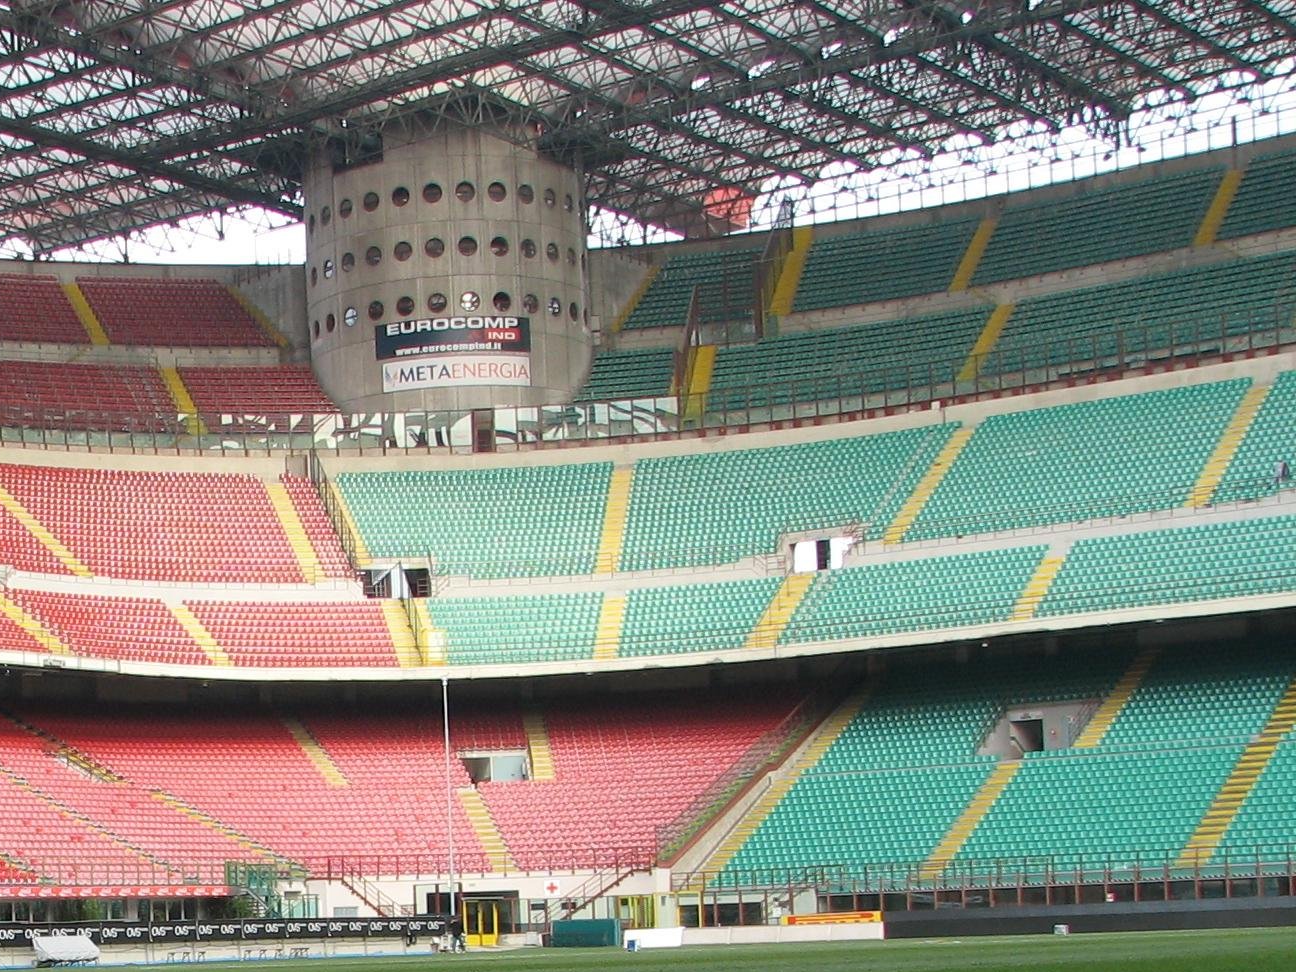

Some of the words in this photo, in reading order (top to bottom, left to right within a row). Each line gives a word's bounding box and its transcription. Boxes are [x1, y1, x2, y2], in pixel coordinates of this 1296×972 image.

[386, 317, 519, 336] EUROCOMP
[488, 331, 516, 340] IND
[395, 342, 501, 356] www.eurocompind.it
[398, 362, 529, 384] METAENERGIA
